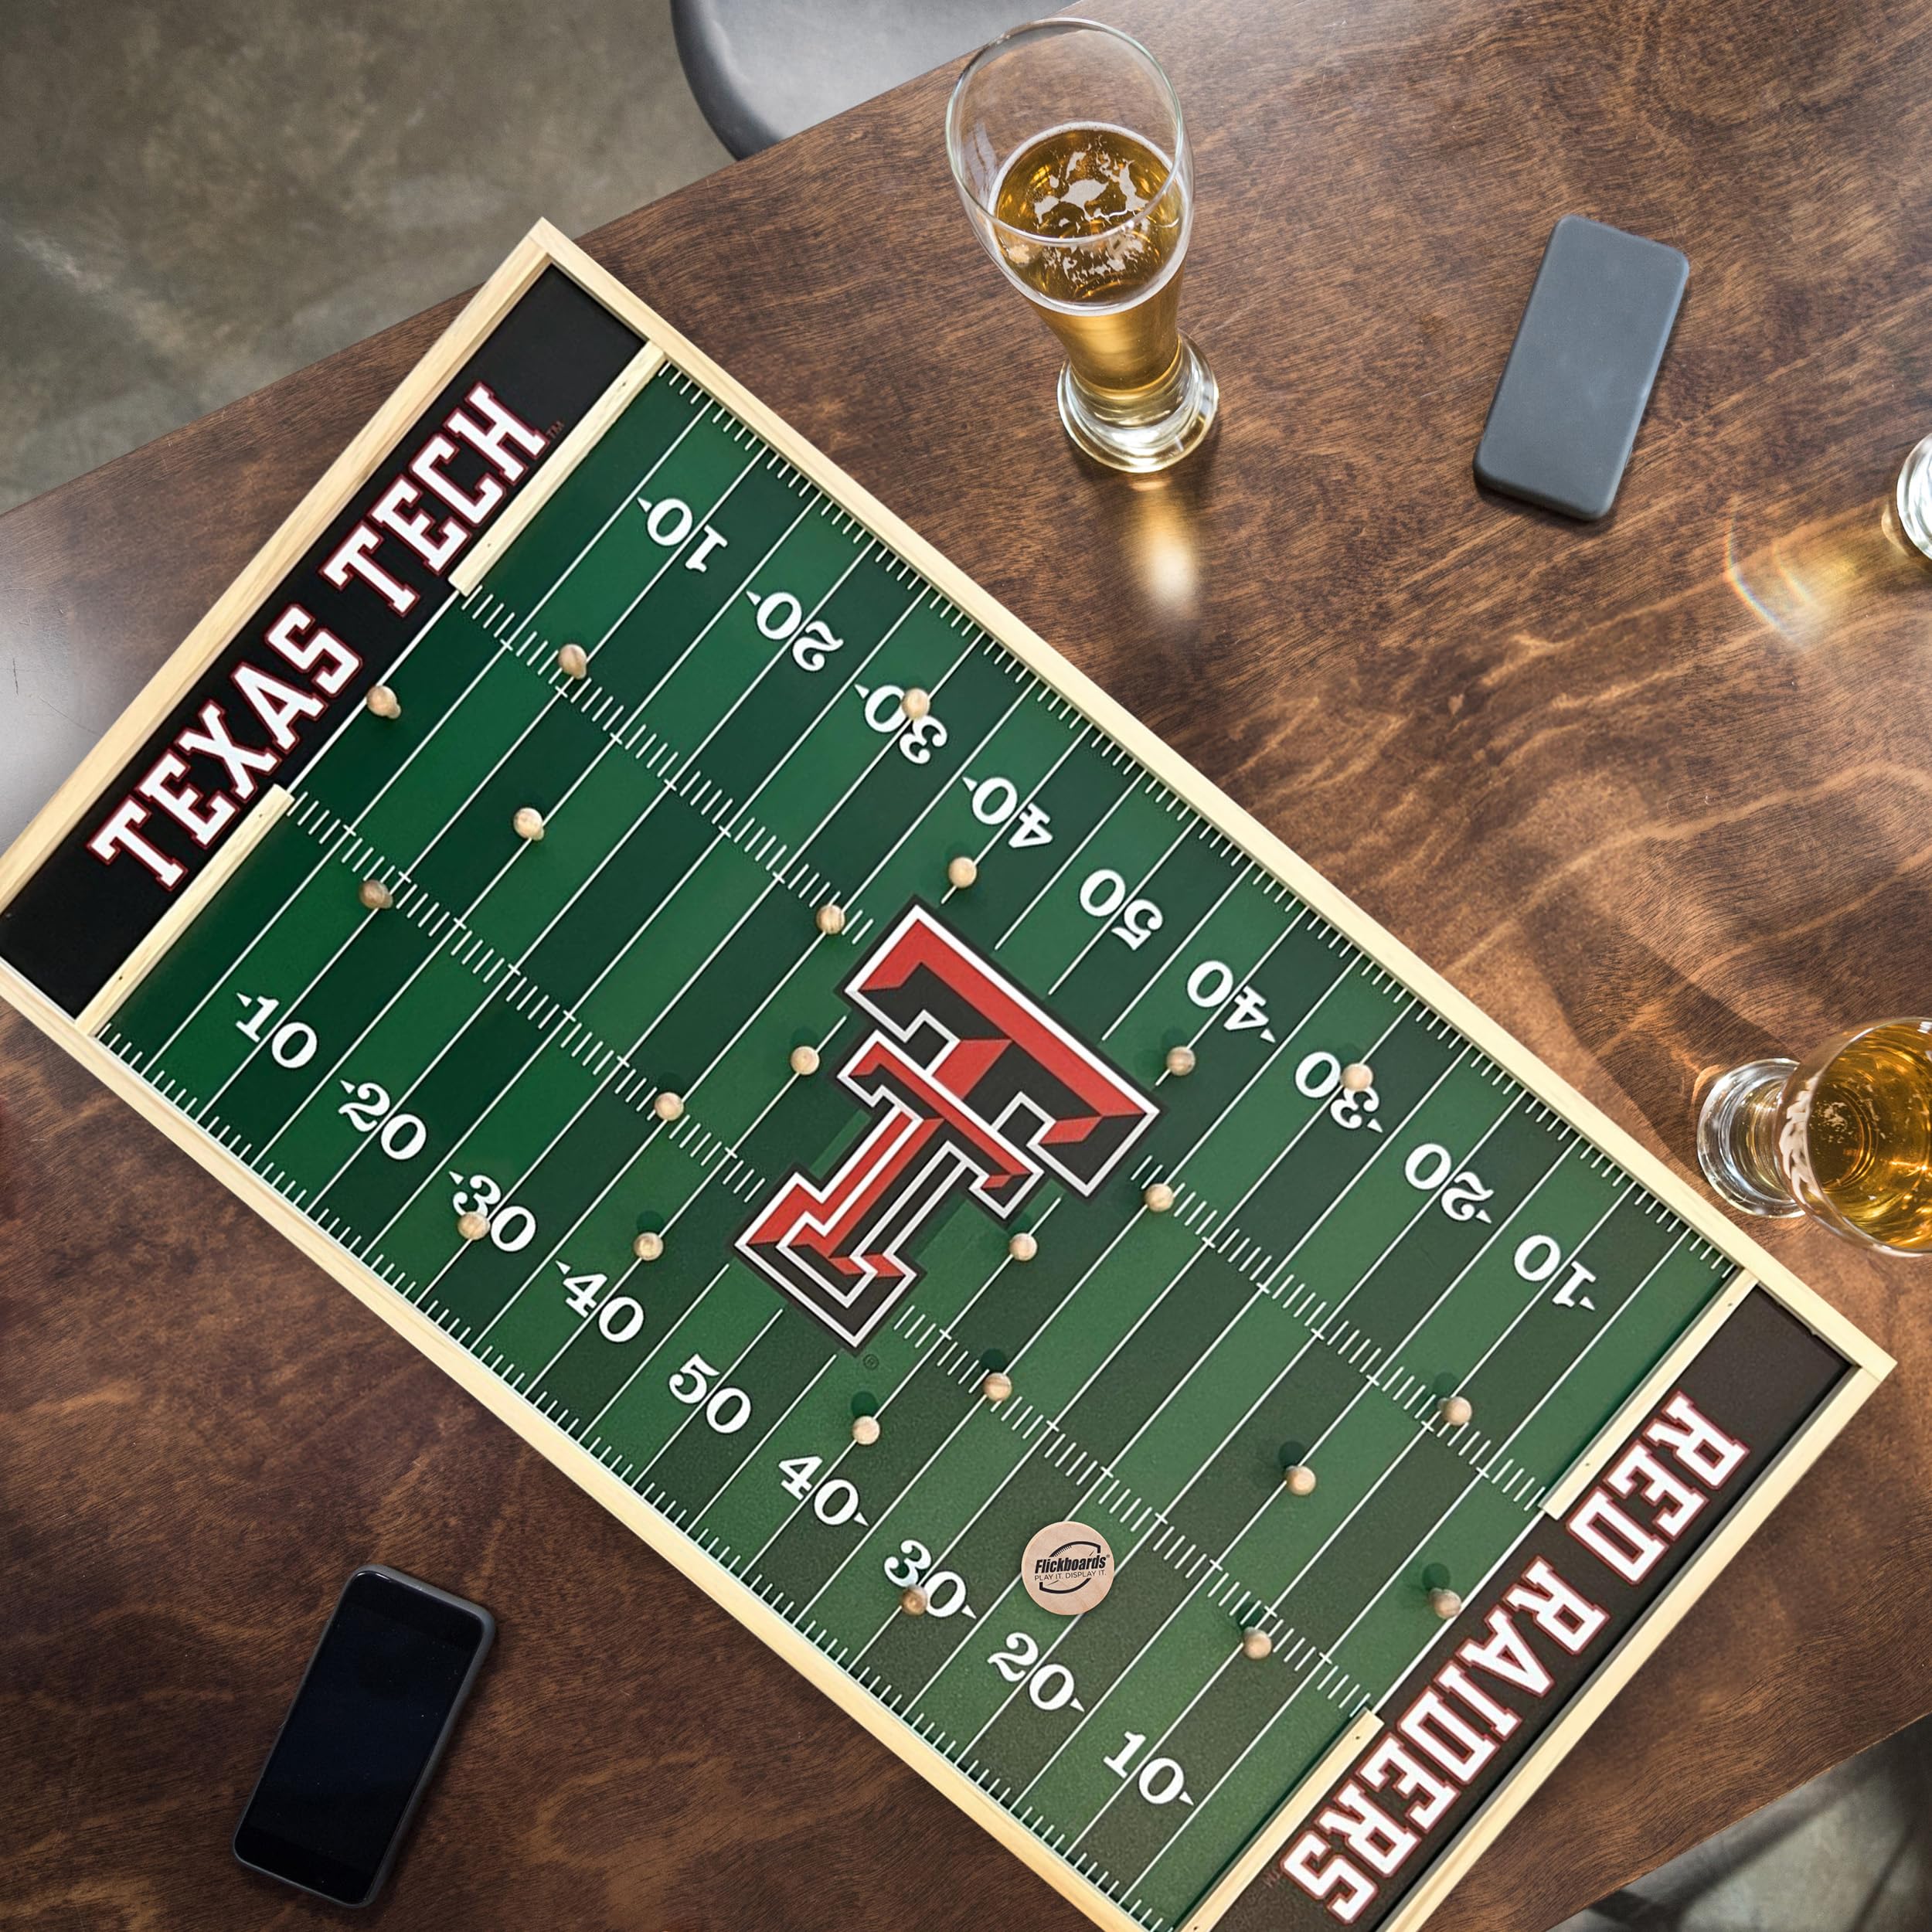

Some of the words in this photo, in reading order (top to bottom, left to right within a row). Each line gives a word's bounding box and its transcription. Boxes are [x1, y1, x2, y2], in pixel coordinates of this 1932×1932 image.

[647, 498, 728, 572] 10
[87, 604, 362, 892] TEXAS
[318, 380, 549, 616] TECH
[756, 592, 844, 672] 20
[865, 685, 947, 764] 30
[972, 777, 1053, 849] 40
[1080, 869, 1163, 951] 50
[235, 995, 318, 1069] 10
[1187, 961, 1270, 1032] 40
[338, 1082, 427, 1160] 20
[1294, 1052, 1381, 1129] 30
[452, 1175, 536, 1252] 30
[1404, 1144, 1494, 1221] 20
[563, 1271, 644, 1342] 40
[1514, 1235, 1597, 1310] 10
[668, 1353, 751, 1434] 50
[778, 1454, 859, 1526] 40
[1566, 1391, 1750, 1586] RED
[883, 1539, 967, 1617] 30
[1066, 1570, 1096, 1579] DISPLAY
[988, 1631, 1075, 1710] 20
[1103, 1730, 1185, 1804] 10
[1280, 1555, 1611, 1924] RAIDERS
